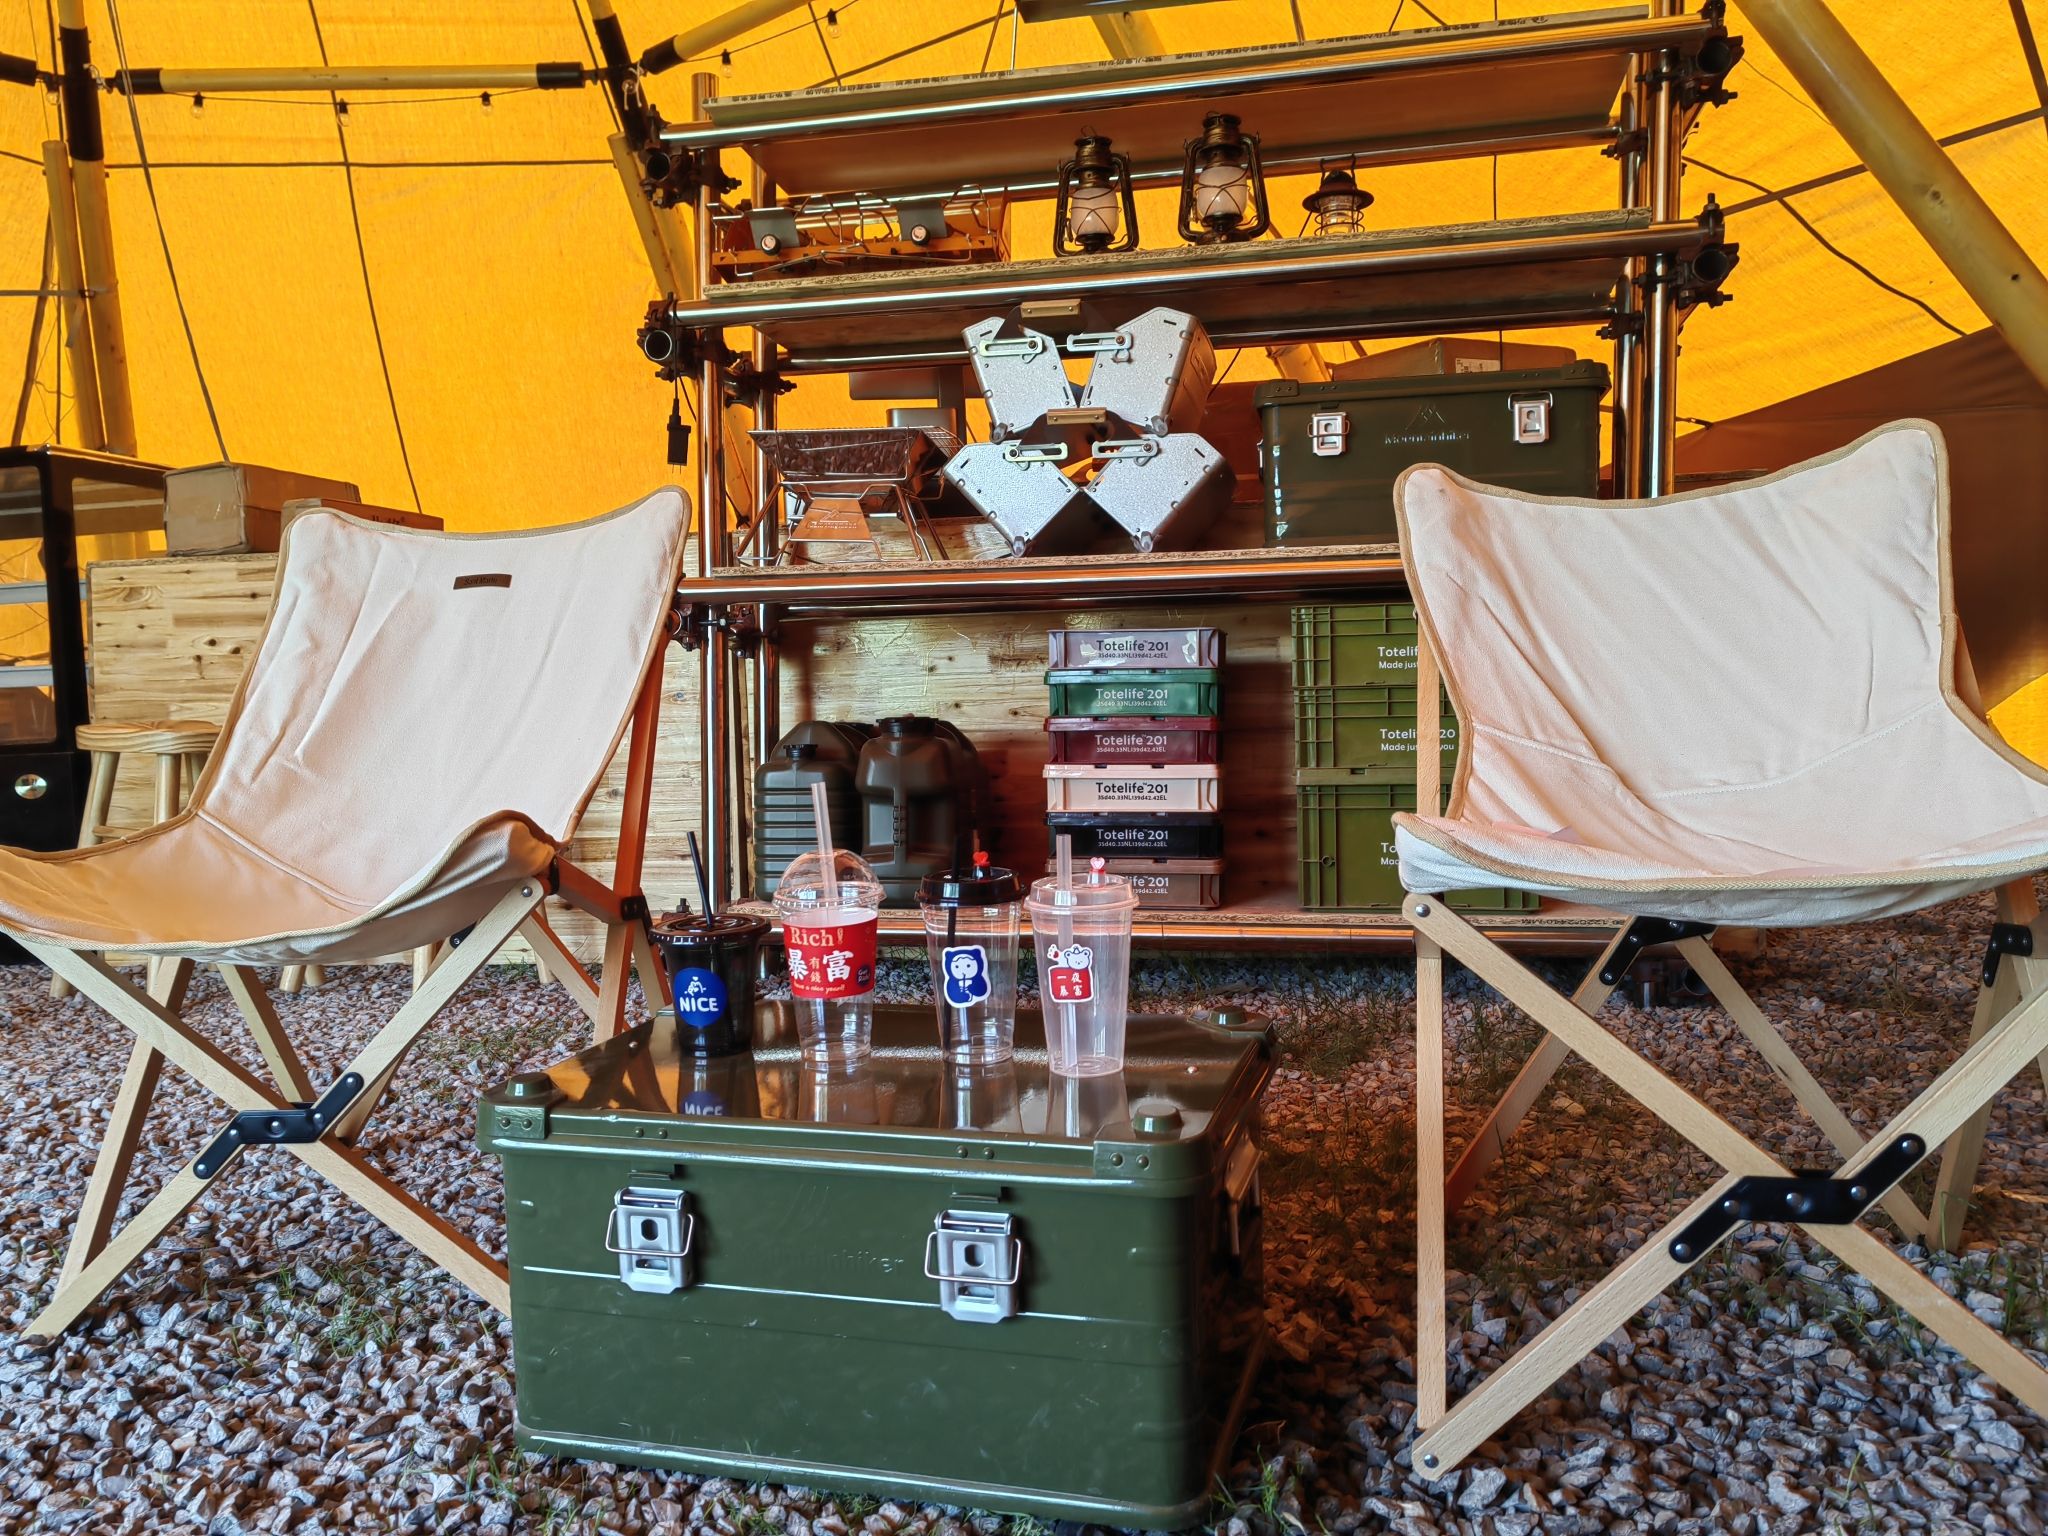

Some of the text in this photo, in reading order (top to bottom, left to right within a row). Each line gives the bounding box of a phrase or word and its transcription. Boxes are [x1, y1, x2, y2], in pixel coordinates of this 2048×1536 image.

[1148, 641, 1168, 651] 201
[1377, 645, 1418, 657] Totelif
[1378, 661, 1418, 670] Made jus
[1147, 689, 1168, 699] 201
[1146, 735, 1167, 746] 201
[1381, 743, 1405, 751] Made
[1147, 783, 1168, 794] 201
[1148, 830, 1168, 840] 201
[1148, 877, 1168, 887] 201
[679, 996, 719, 1012] NICE
